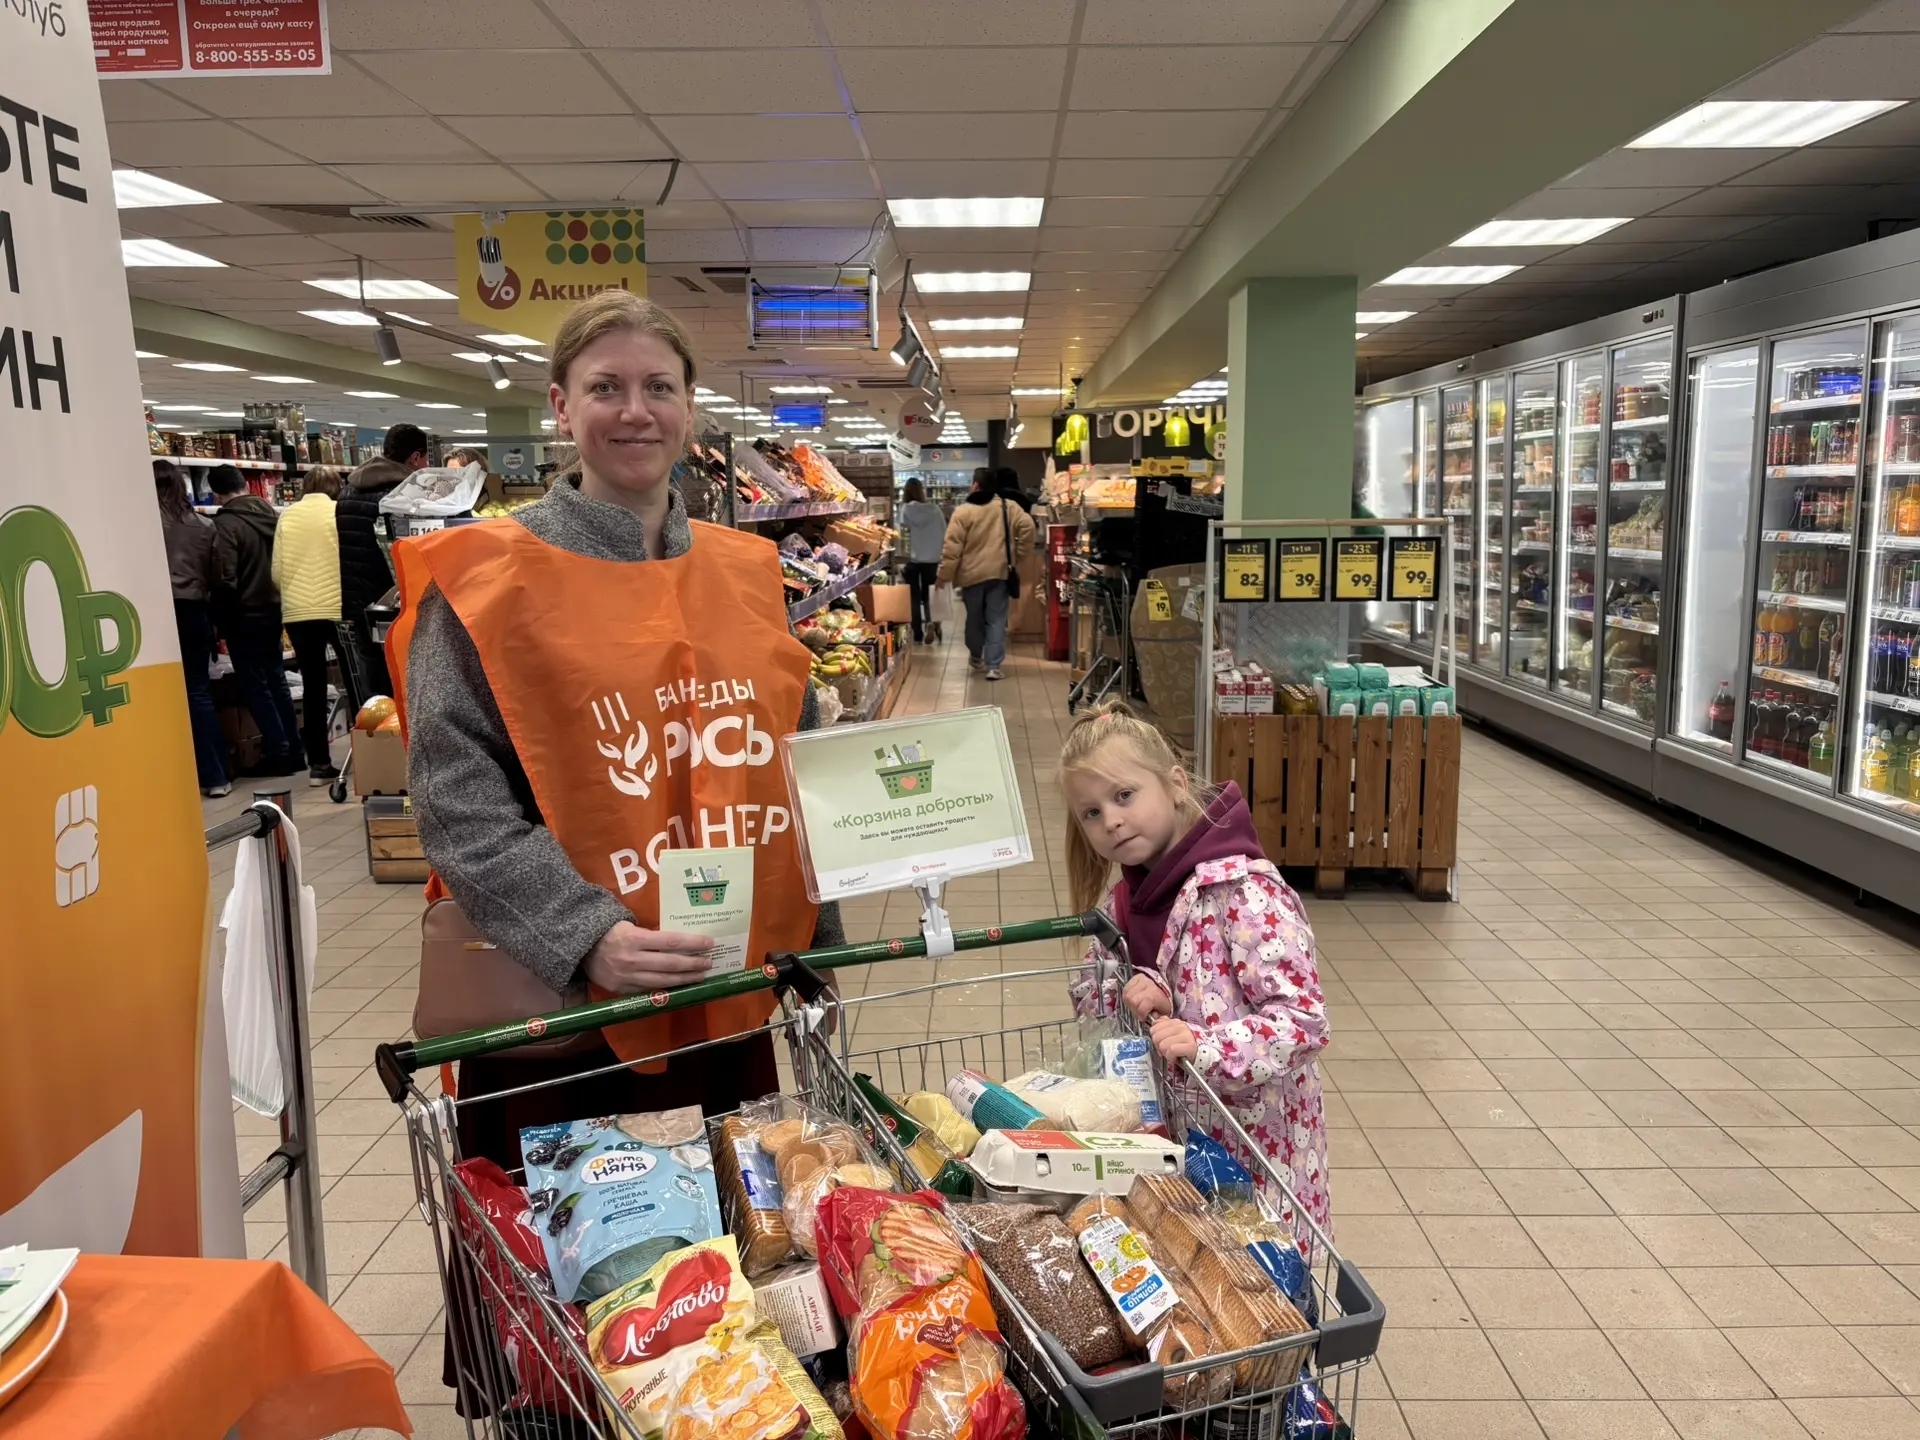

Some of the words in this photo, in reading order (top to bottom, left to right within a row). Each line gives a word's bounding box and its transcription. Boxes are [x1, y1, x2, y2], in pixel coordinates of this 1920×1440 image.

[233, 7, 280, 18] очереди?
[119, 20, 161, 28] продажа
[193, 21, 237, 31] Откроем
[238, 20, 259, 30] ещё
[260, 20, 285, 30] одну
[287, 20, 315, 30] кассу
[117, 29, 170, 38] продукции,
[127, 38, 170, 46] напитков
[196, 48, 317, 64] 8-800-555-55-05
[1240, 573, 1260, 587] 82
[1295, 573, 1315, 587] 39
[1351, 574, 1372, 587] 99
[1406, 570, 1427, 584] 99
[832, 806, 912, 829] «Корзина
[915, 793, 994, 818] доброты»
[859, 833, 880, 841] Здесь
[890, 826, 914, 836] можете
[915, 821, 945, 831] оставить
[944, 815, 976, 825] продукты
[903, 826, 949, 840] нуждающихся
[669, 910, 713, 921] Пожертвуйте
[713, 908, 744, 919] продукты
[623, 1142, 639, 1150] 4+
[1106, 1159, 1124, 1168] ЯЙЦО
[593, 1162, 648, 1181] НЯНЯ
[602, 1190, 649, 1208] ГРЕЧНЕВАЯ
[614, 1198, 639, 1210] КАША
[610, 1206, 646, 1219] МОЛОЧНАЯ
[1127, 1281, 1158, 1308] КОЛЬЦО
[807, 1295, 823, 1332] АЗЕРЧАЙ
[616, 1280, 726, 1363] Любятово
